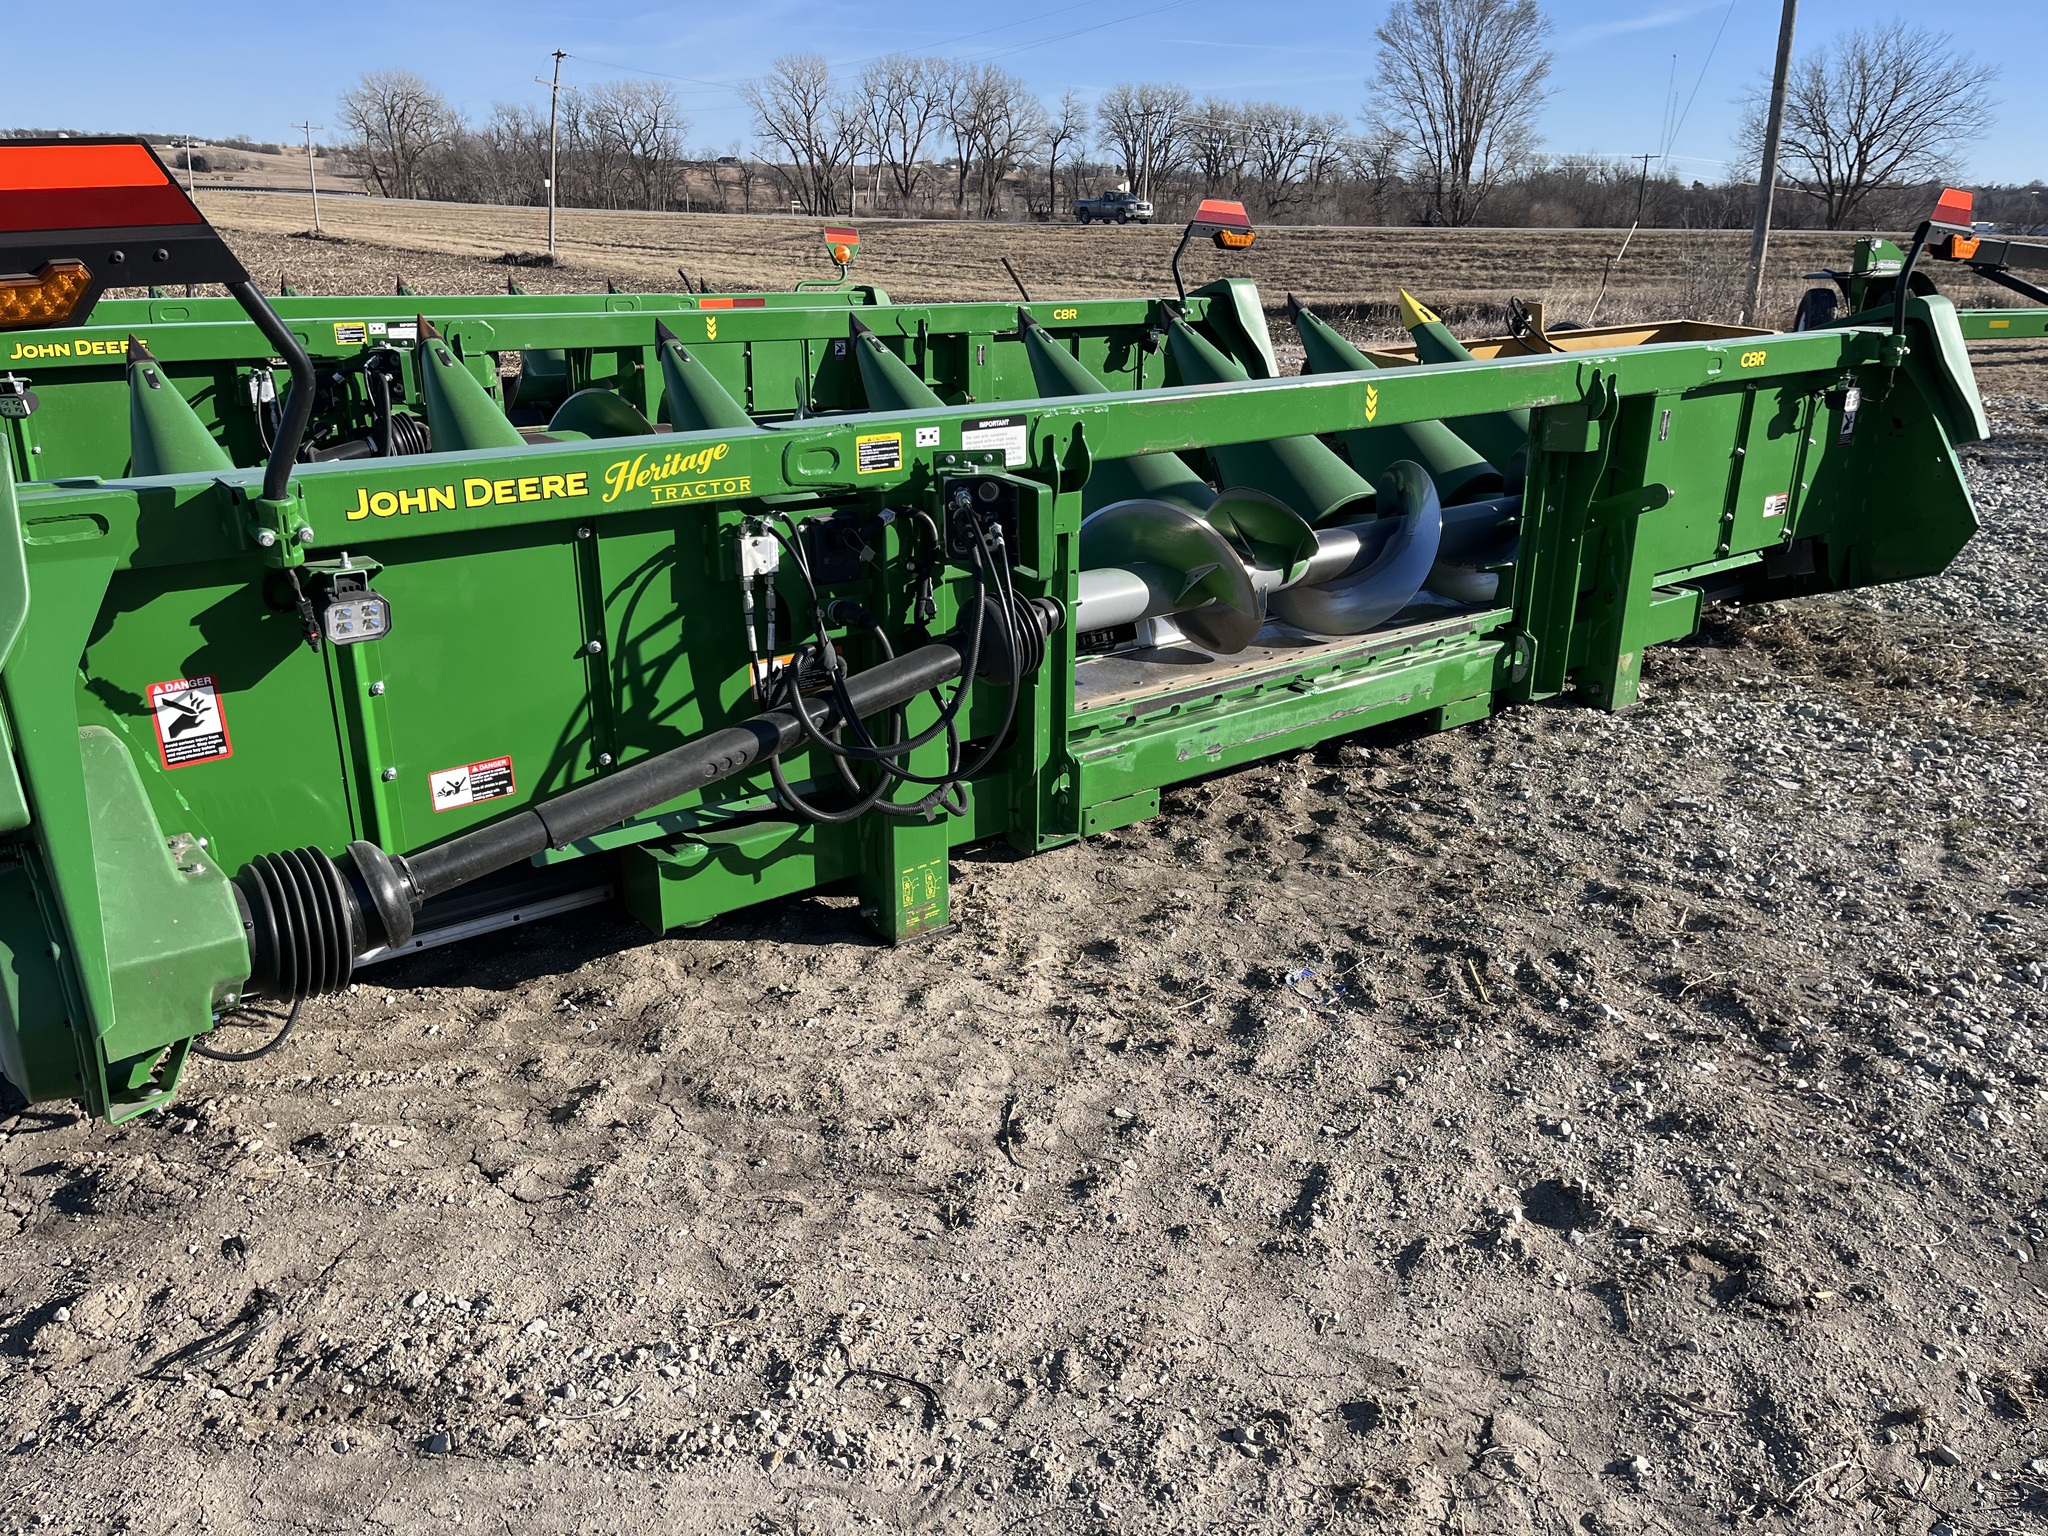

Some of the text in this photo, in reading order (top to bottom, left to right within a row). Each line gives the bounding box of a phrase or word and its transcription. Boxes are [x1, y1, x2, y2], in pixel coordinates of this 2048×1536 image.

[1054, 309, 1078, 320] C8R
[10, 343, 71, 360] JOHN
[1740, 350, 1766, 368] C8R
[979, 419, 1010, 428] IMPORTANT
[602, 443, 729, 502] Heritage
[346, 472, 589, 521] JOHN DEERE
[651, 479, 751, 501] TRACTOR
[165, 677, 212, 692] DANGER
[479, 760, 506, 770] DANGER
